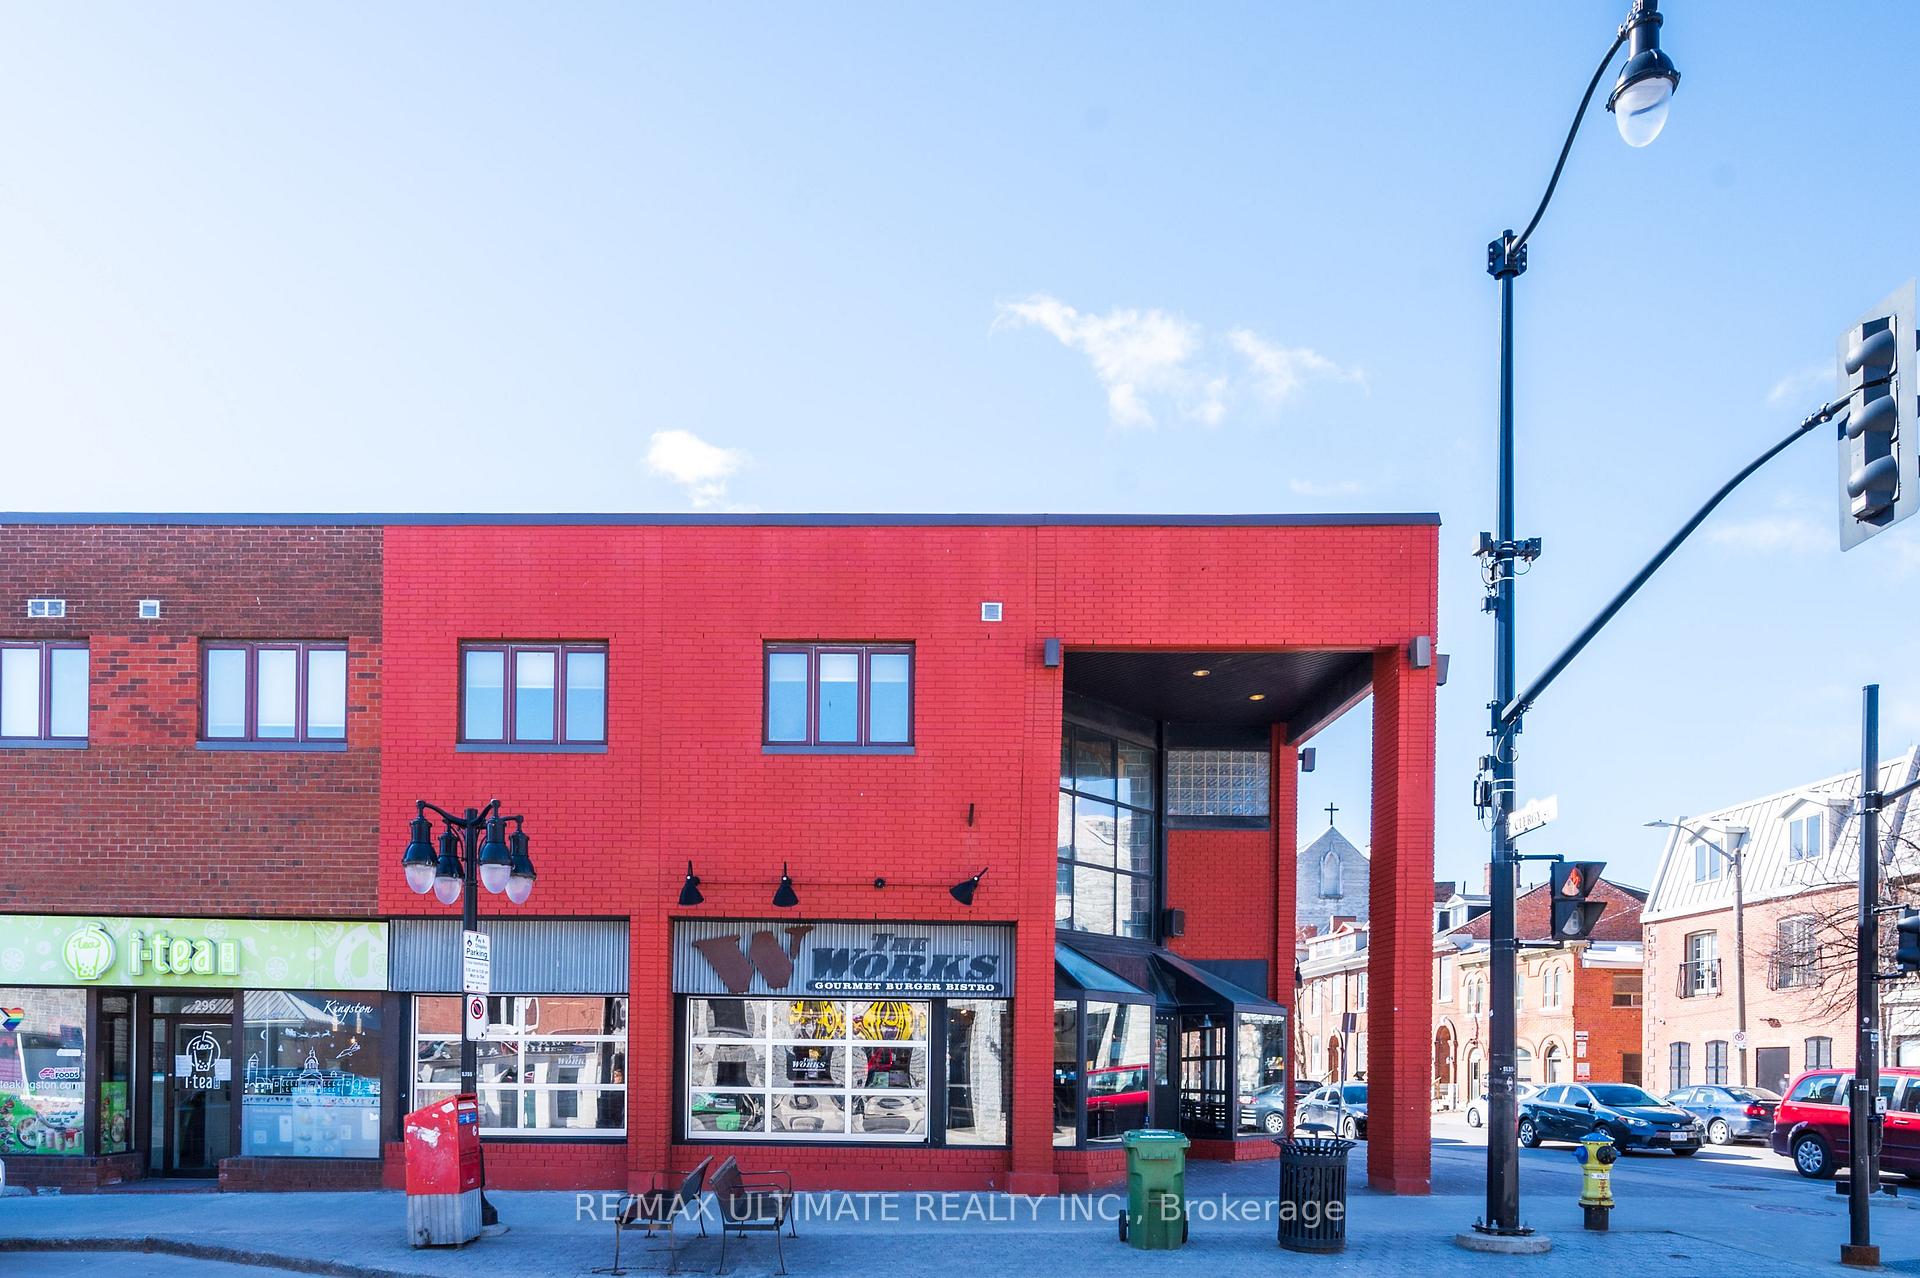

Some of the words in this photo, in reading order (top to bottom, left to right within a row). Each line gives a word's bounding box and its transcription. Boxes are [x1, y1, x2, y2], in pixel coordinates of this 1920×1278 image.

[466, 947, 488, 959] Parking
[812, 948, 1000, 980] WORKS
[814, 982, 882, 990] GOURMET
[886, 982, 941, 991] BURGER
[945, 983, 995, 991] BISTRO
[195, 1000, 216, 1011] 296
[323, 1000, 374, 1024] Kingston
[792, 1060, 826, 1069] WORKS
